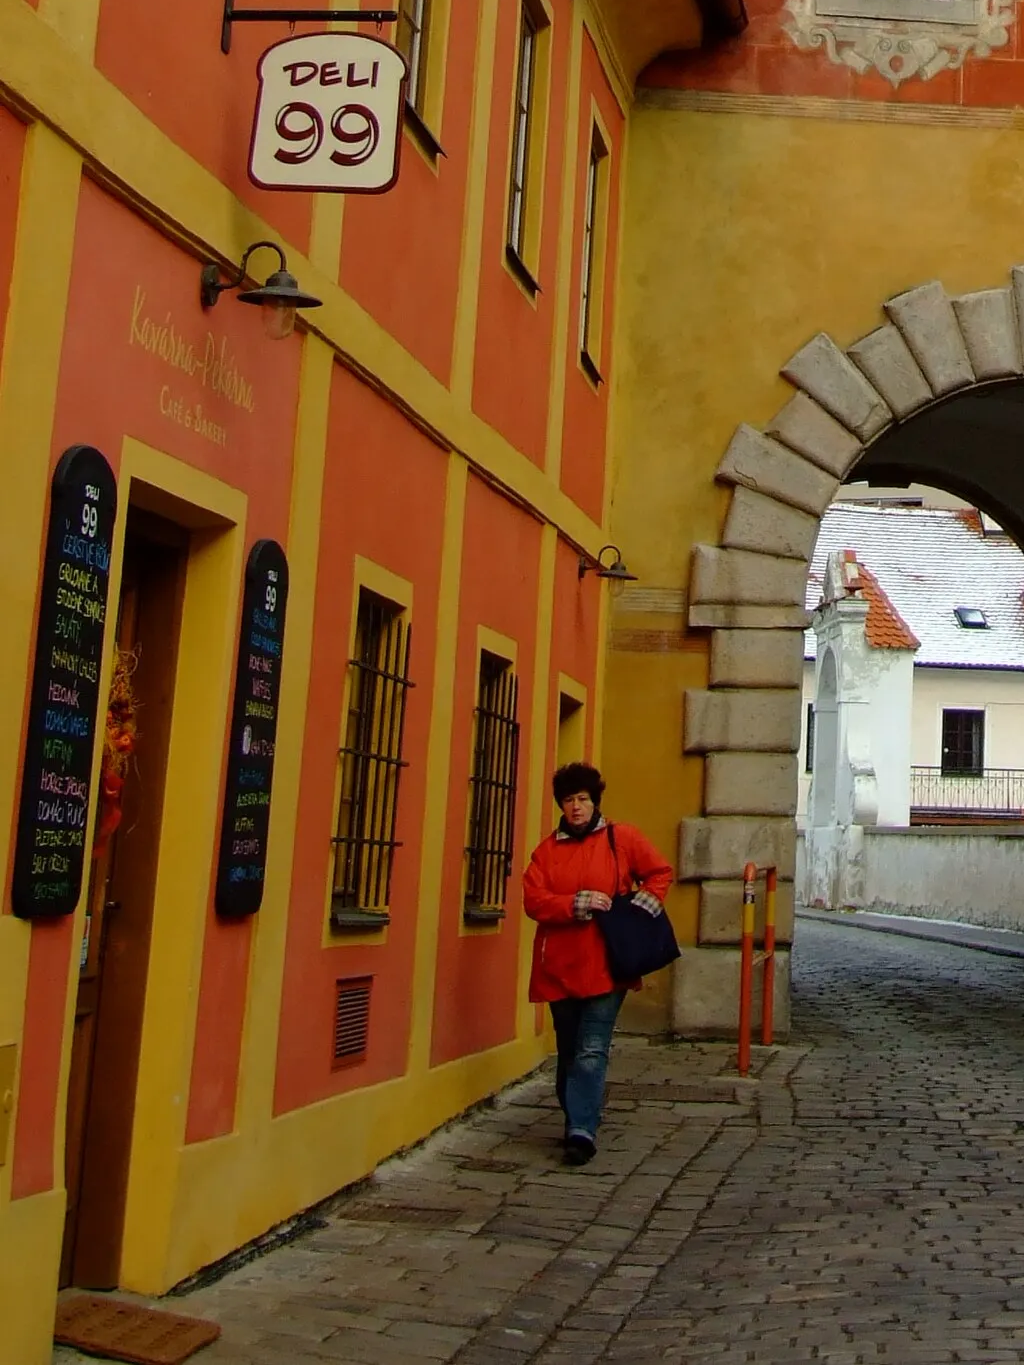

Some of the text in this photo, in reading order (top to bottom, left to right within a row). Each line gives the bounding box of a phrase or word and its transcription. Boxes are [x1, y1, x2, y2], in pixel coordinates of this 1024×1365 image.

[283, 61, 379, 89] DELI
[273, 102, 379, 166] 99
[85, 484, 100, 501] DELI
[81, 503, 98, 538] 99
[264, 585, 277, 613] 99
